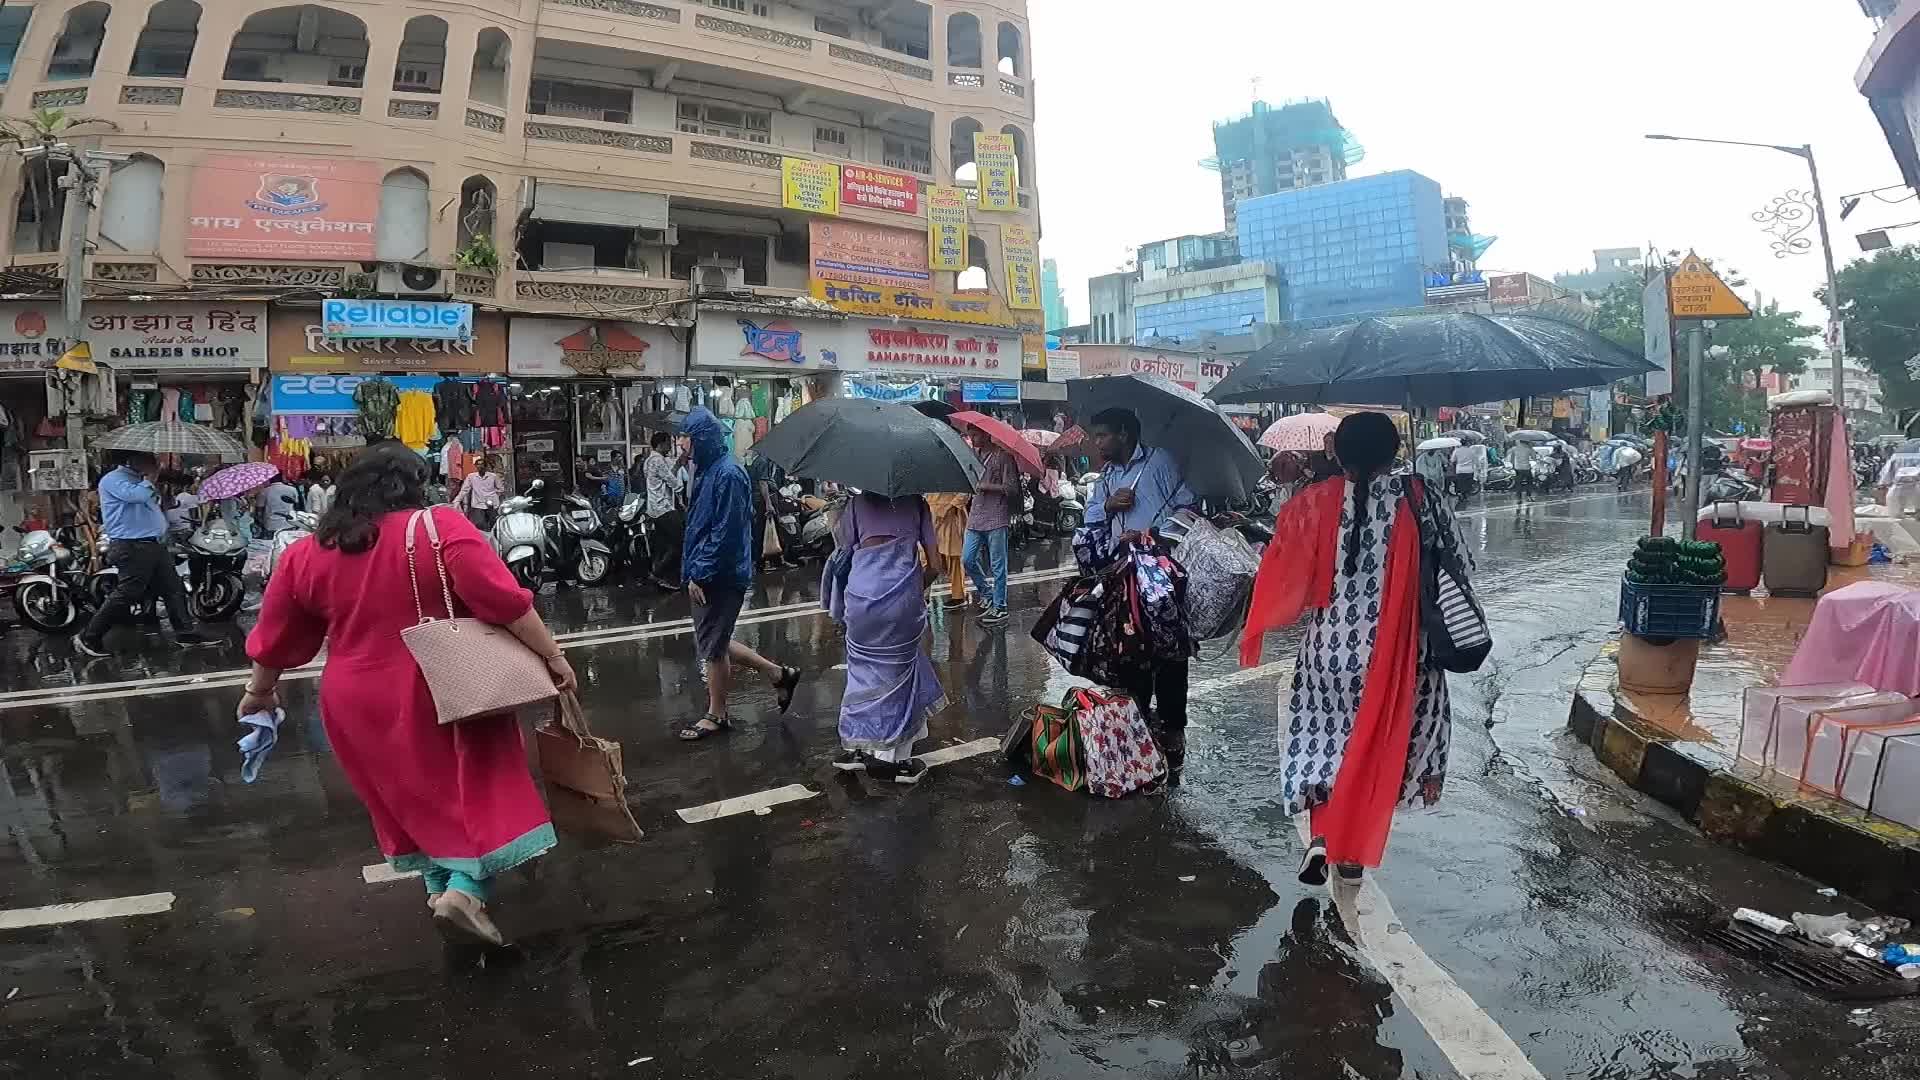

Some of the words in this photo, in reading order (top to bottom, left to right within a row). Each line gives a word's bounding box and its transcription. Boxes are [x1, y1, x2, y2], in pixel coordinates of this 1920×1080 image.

[88, 315, 194, 333] आझाद
[207, 309, 258, 334] हिंद
[327, 302, 459, 325] Reliable
[0, 342, 41, 356] झाद
[110, 347, 183, 358] SAREES
[192, 347, 240, 358] SHOP
[1143, 354, 1184, 379] कशिश
